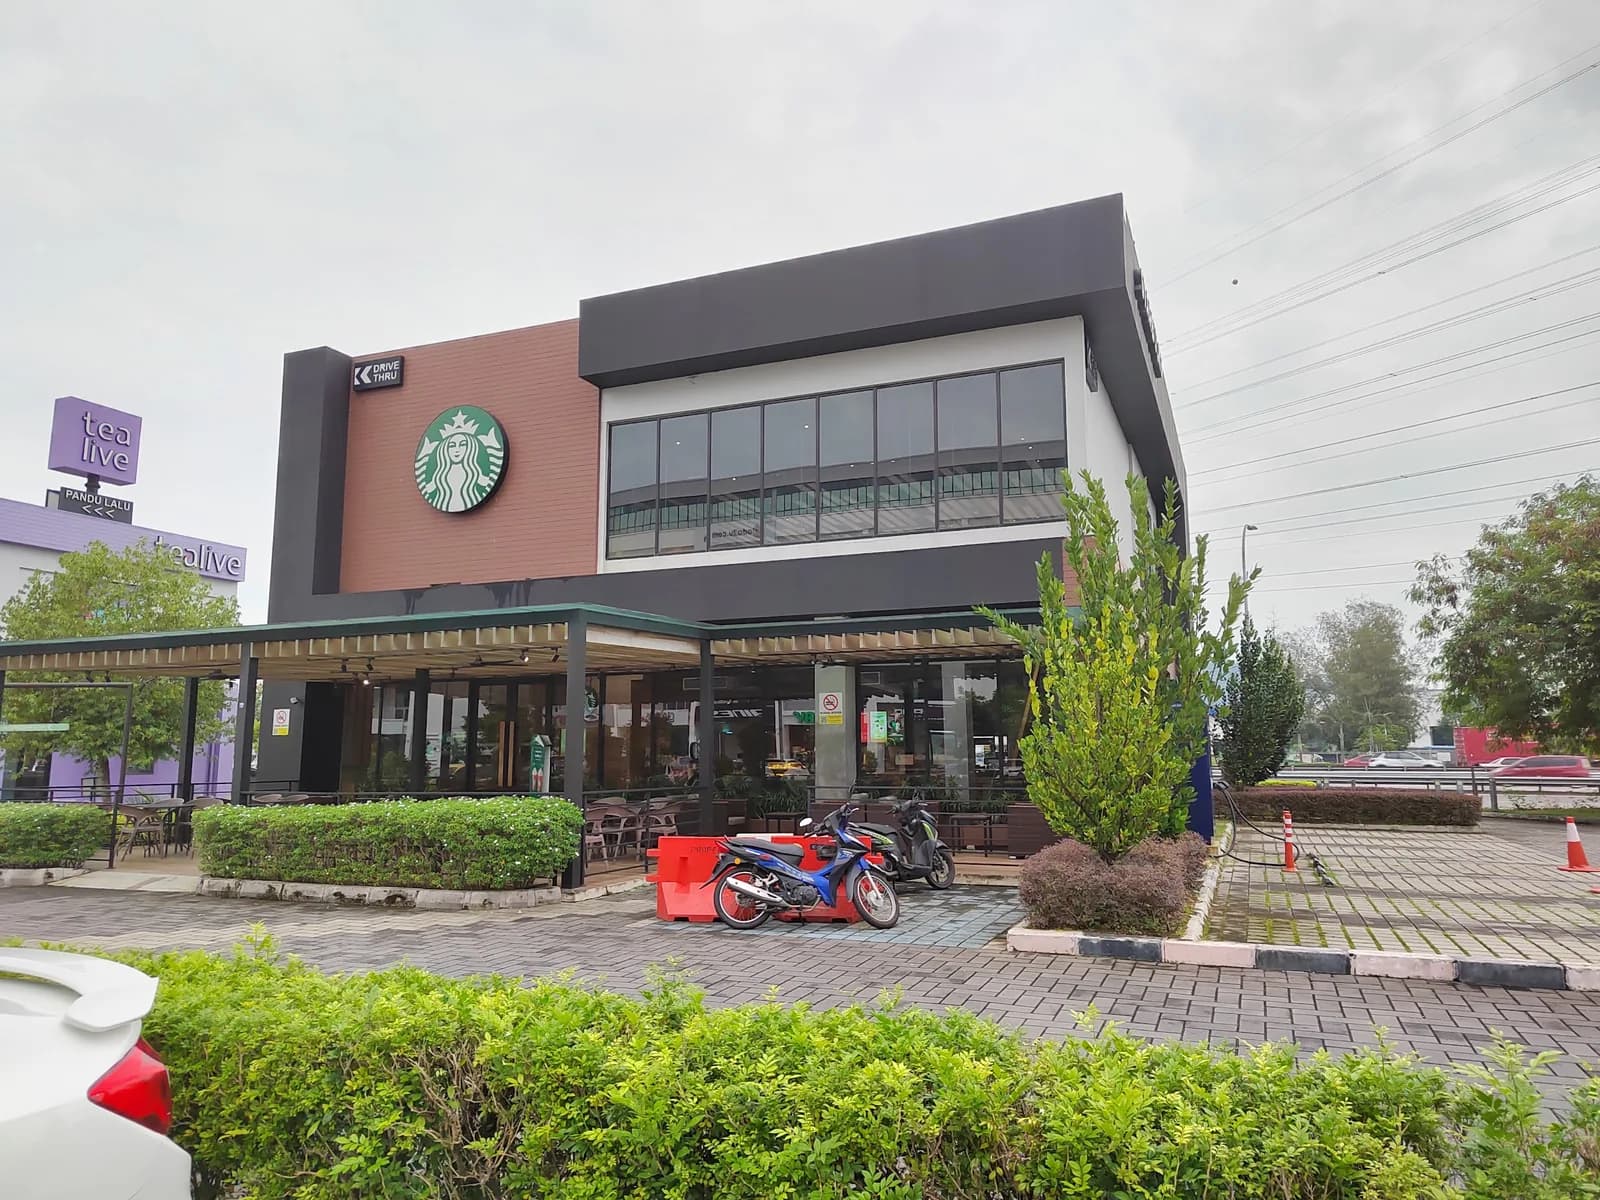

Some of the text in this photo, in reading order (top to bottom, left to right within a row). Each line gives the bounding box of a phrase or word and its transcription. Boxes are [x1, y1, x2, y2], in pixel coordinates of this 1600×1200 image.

[373, 360, 400, 373] DRIVE
[373, 370, 397, 382] THRU
[82, 411, 130, 446] tea
[81, 437, 129, 471] live
[65, 489, 131, 511] PANDU LALU
